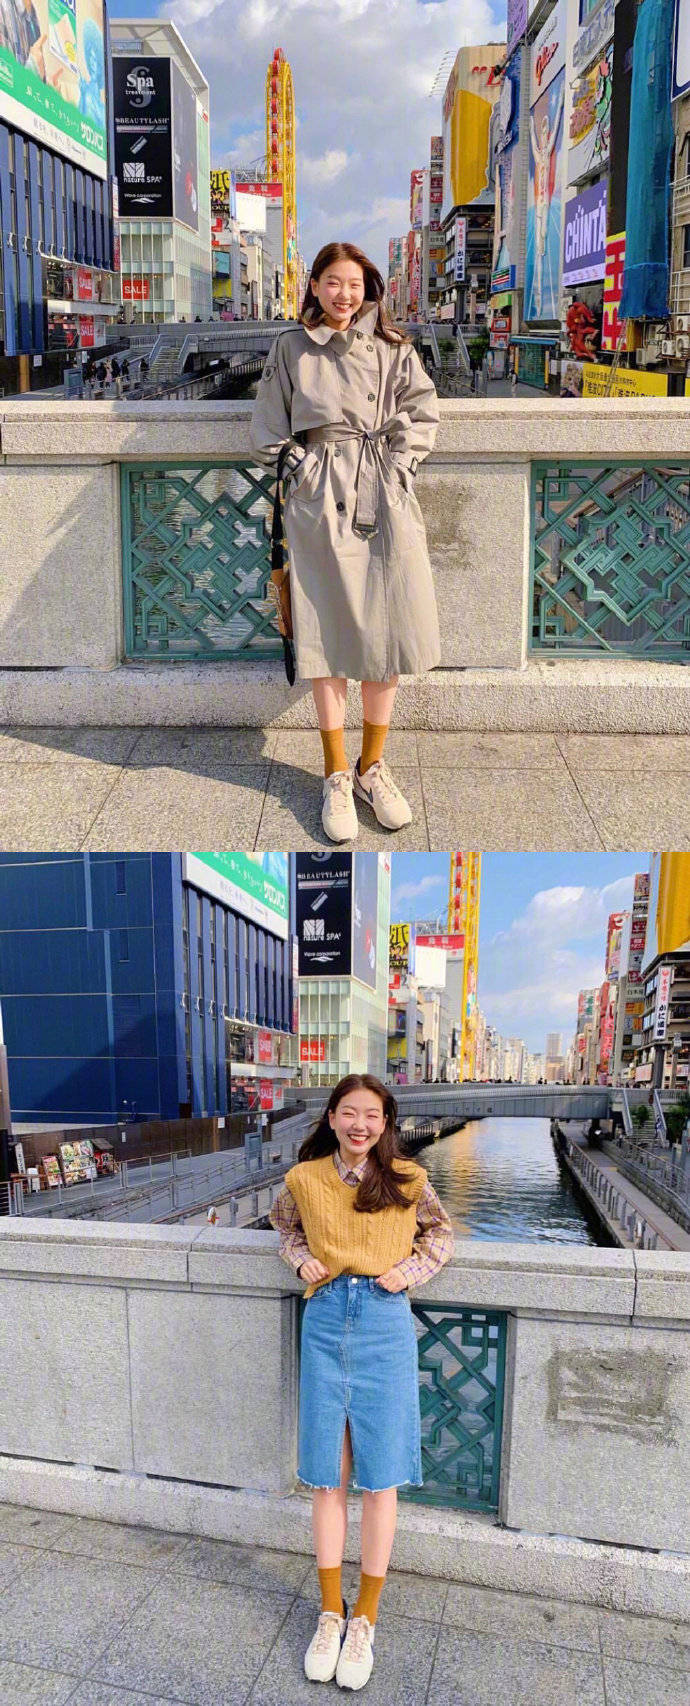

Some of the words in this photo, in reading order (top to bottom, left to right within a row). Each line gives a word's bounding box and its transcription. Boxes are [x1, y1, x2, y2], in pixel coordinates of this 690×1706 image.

[126, 73, 154, 91] Spa
[124, 285, 147, 294] SALE
[81, 324, 94, 336] SALE
[301, 1047, 324, 1056] SALE
[261, 1087, 273, 1098] SALE
